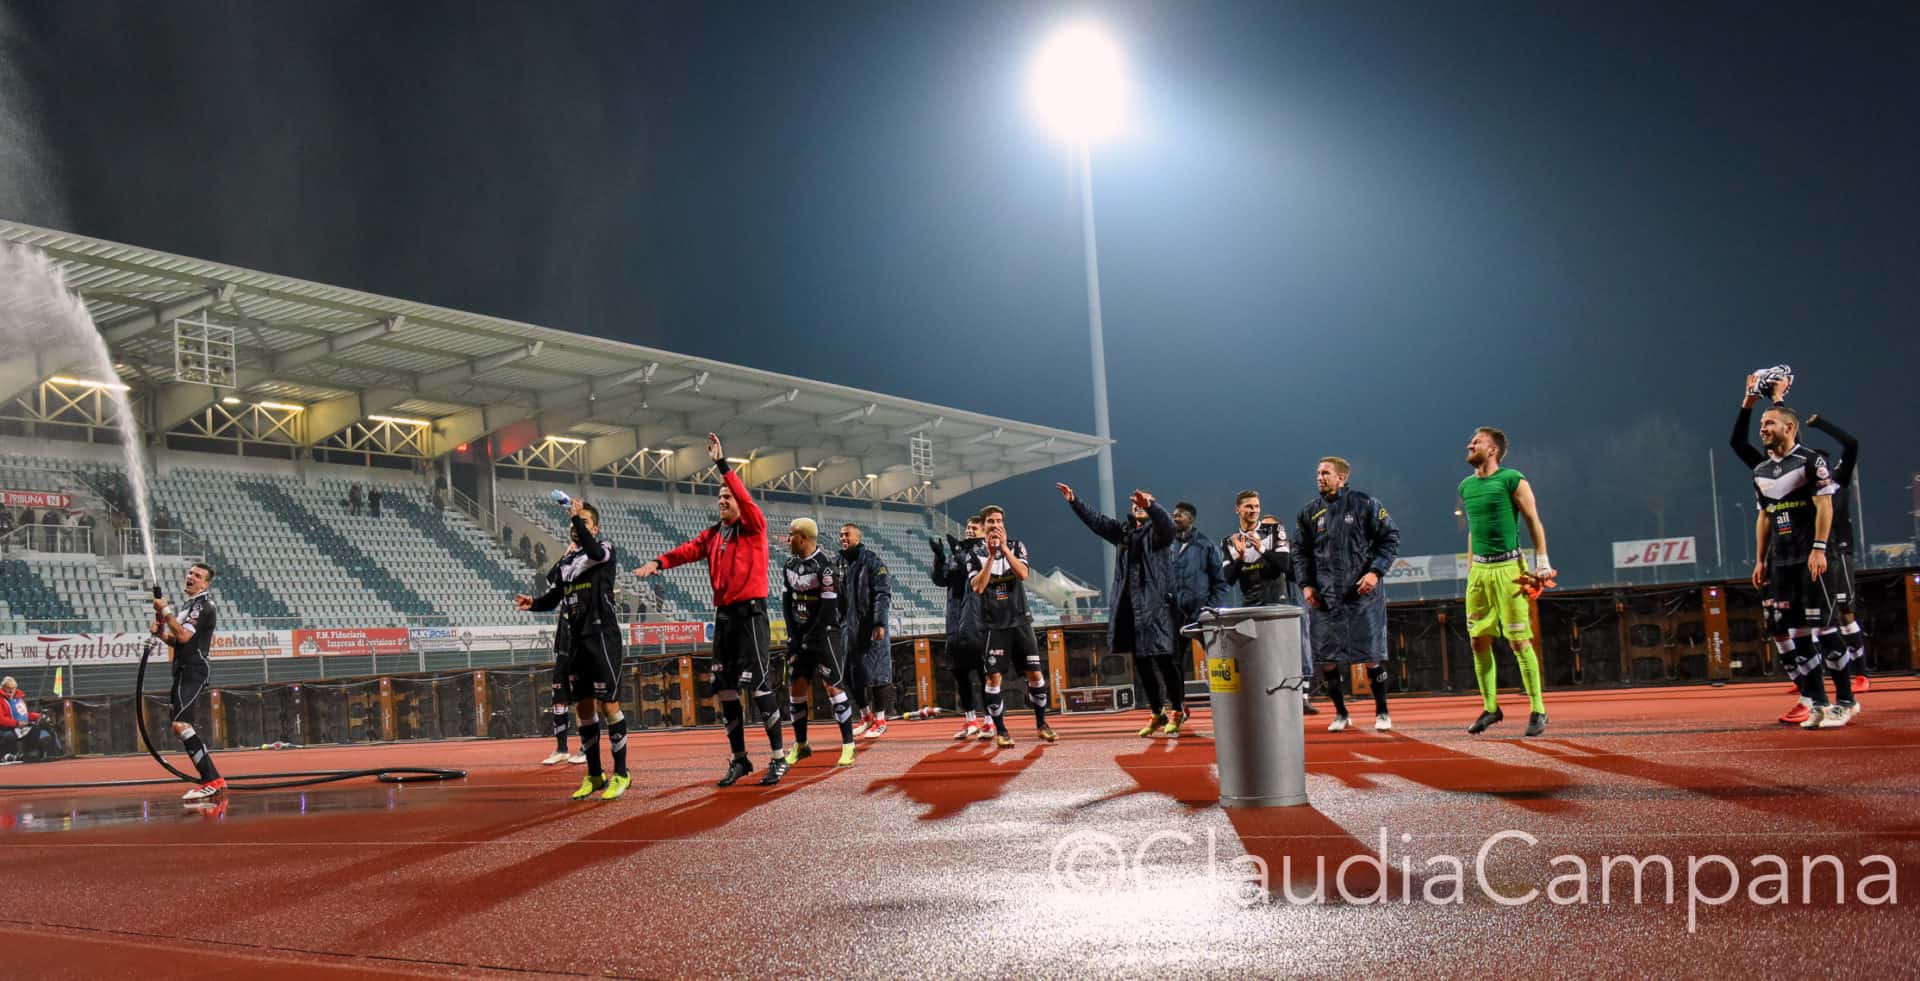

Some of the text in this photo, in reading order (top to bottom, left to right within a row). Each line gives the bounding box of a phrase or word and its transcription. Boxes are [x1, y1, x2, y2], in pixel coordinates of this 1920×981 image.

[10, 495, 44, 505] TRIBUNA
[1776, 511, 1790, 524] ail
[1643, 541, 1690, 563] GTL
[681, 623, 700, 633] SPORT
[21, 646, 38, 658] VINI
